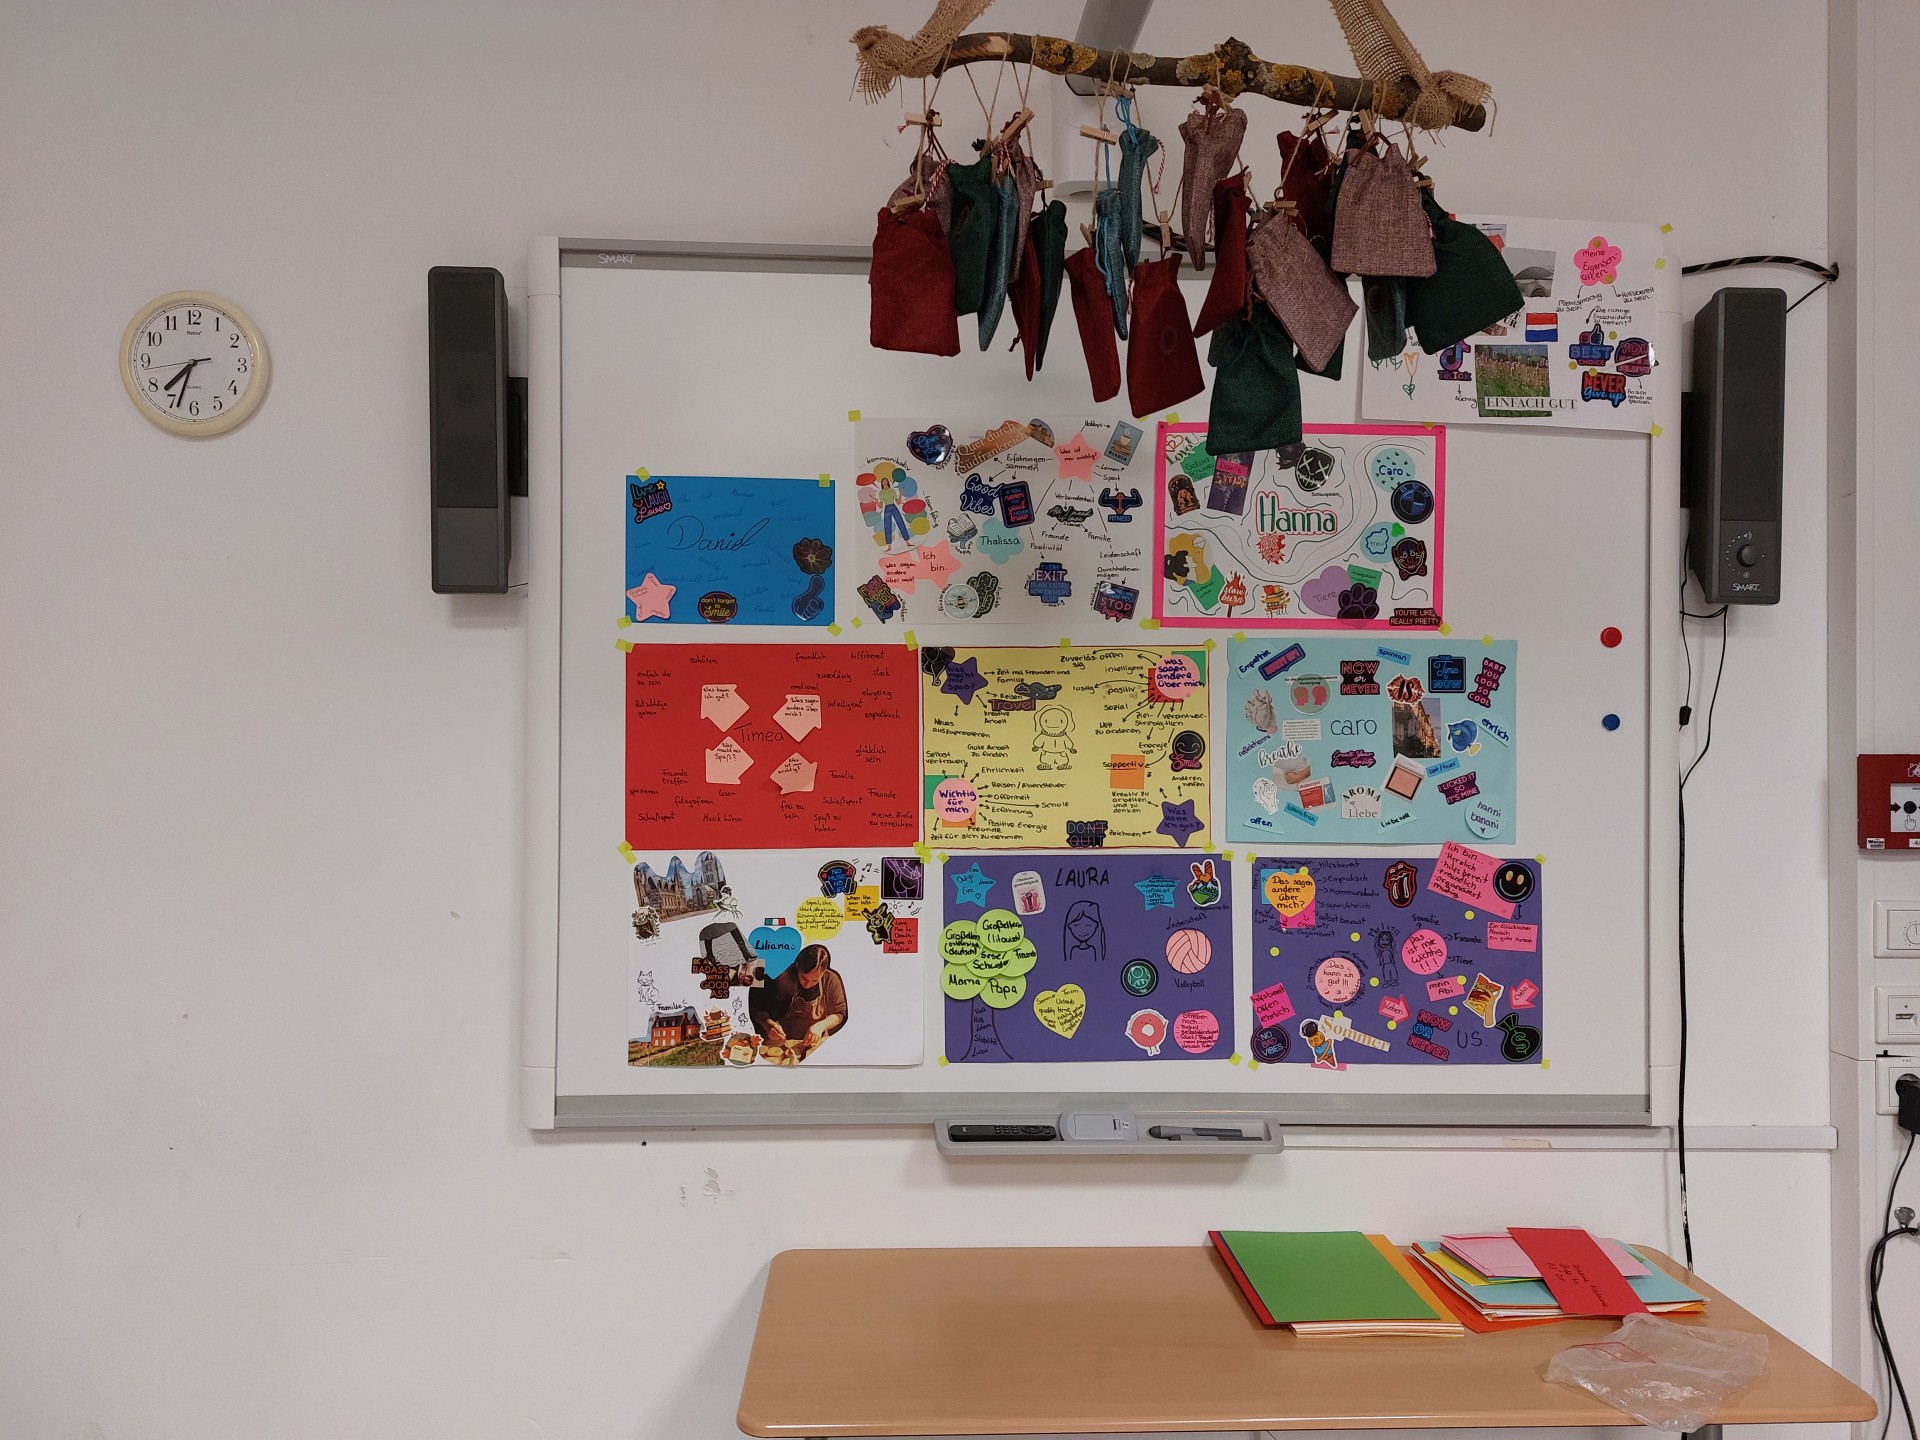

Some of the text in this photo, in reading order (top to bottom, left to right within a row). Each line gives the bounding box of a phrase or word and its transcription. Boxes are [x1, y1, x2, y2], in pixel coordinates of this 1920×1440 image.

[599, 254, 636, 264] SMART
[164, 316, 177, 330] 11
[187, 310, 201, 325] 12
[214, 317, 220, 331] 1
[147, 332, 162, 346] 10
[230, 333, 239, 348] 2
[1570, 347, 1613, 358] BEST
[141, 353, 150, 368] 9
[237, 358, 247, 373] 3
[1439, 371, 1471, 379] TikTok
[148, 378, 158, 392] 8
[228, 380, 238, 395] 4
[1584, 373, 1625, 392] NEVER
[167, 394, 176, 408] 7
[213, 396, 222, 411] 5
[1487, 397, 1577, 409] EINFACH GUT
[189, 401, 199, 416] 6
[958, 422, 1016, 455] Quer durch
[959, 431, 1028, 474] Südfrankreich
[1007, 454, 1046, 463] Erfahrungen
[1005, 463, 1038, 471] sammeln
[1220, 462, 1242, 473] Don't
[1379, 465, 1403, 475] Caro
[966, 474, 998, 498] Good
[631, 484, 656, 501] Live
[644, 491, 670, 509] LAUGH
[961, 494, 994, 515] Vibes
[635, 505, 663, 522] Love
[1259, 495, 1336, 532] Hanna
[666, 515, 770, 551] Daniel
[1042, 531, 1070, 541] Freunde
[1088, 532, 1111, 542] Familie
[980, 535, 1021, 545] Thalissa
[1100, 549, 1141, 558] Leidenschaft
[1036, 571, 1065, 580] EXIT
[1732, 583, 1760, 591] SMART
[1313, 592, 1336, 602] Tiere
[1101, 598, 1131, 611] STOP
[704, 605, 730, 618] Smile
[796, 652, 826, 661] freundlich
[1100, 652, 1123, 660] offen
[1105, 666, 1143, 674] intelligent
[1342, 662, 1379, 674] NOW
[1434, 661, 1459, 676] Time
[1484, 660, 1504, 672] BABE
[1483, 669, 1499, 679] YOU
[1184, 679, 1204, 687] mich
[1342, 684, 1379, 693] NEVER
[1433, 680, 1461, 688] NOW
[1476, 676, 1498, 689] LOOK
[1073, 686, 1095, 694] lustig
[1108, 687, 1136, 695] positiv
[1398, 680, 1414, 700] IS
[828, 698, 862, 710] intelligent
[992, 701, 1034, 709] Travel
[1469, 693, 1490, 706] COOL
[865, 709, 900, 721] empathisch
[733, 722, 785, 743] Timea
[1331, 719, 1377, 735] caro
[856, 745, 886, 756] glücklich
[1260, 741, 1300, 766] breathe
[829, 770, 854, 779] Familie
[868, 788, 896, 798] Freunde
[1342, 786, 1381, 802] AROMA
[1455, 785, 1465, 793] SO
[939, 790, 976, 801] Wichtig
[1447, 788, 1478, 804] IT'S MINE
[1168, 807, 1186, 815] Was
[1349, 809, 1377, 818] Liebe
[1478, 802, 1501, 817] hanni
[880, 820, 912, 828] erreichen
[988, 820, 1048, 832] Positive Energie
[1250, 818, 1272, 827] offen
[1471, 812, 1499, 829] banani
[1068, 822, 1106, 833] DON'T
[1069, 836, 1103, 846] QUIT
[1055, 867, 1109, 888] LAURA
[1272, 876, 1312, 888] Das sagen
[1433, 883, 1458, 898] mutig
[1277, 901, 1305, 909] mich?
[1412, 914, 1439, 925] Familie
[1326, 961, 1344, 969] Das
[949, 974, 980, 985] Mama
[1174, 979, 1204, 992] Volleyball
[1429, 981, 1449, 989] mein
[988, 978, 1017, 999] Papa
[656, 1002, 682, 1011] Familie
[1261, 1007, 1289, 1022] ehrlich
[1419, 1012, 1452, 1031] NOW
[1322, 1017, 1390, 1051] Sommer
[1414, 1024, 1432, 1038] OR
[1262, 1038, 1277, 1048] BAD
[1409, 1035, 1449, 1060] NEVER
[1262, 1044, 1283, 1056] VIBES
